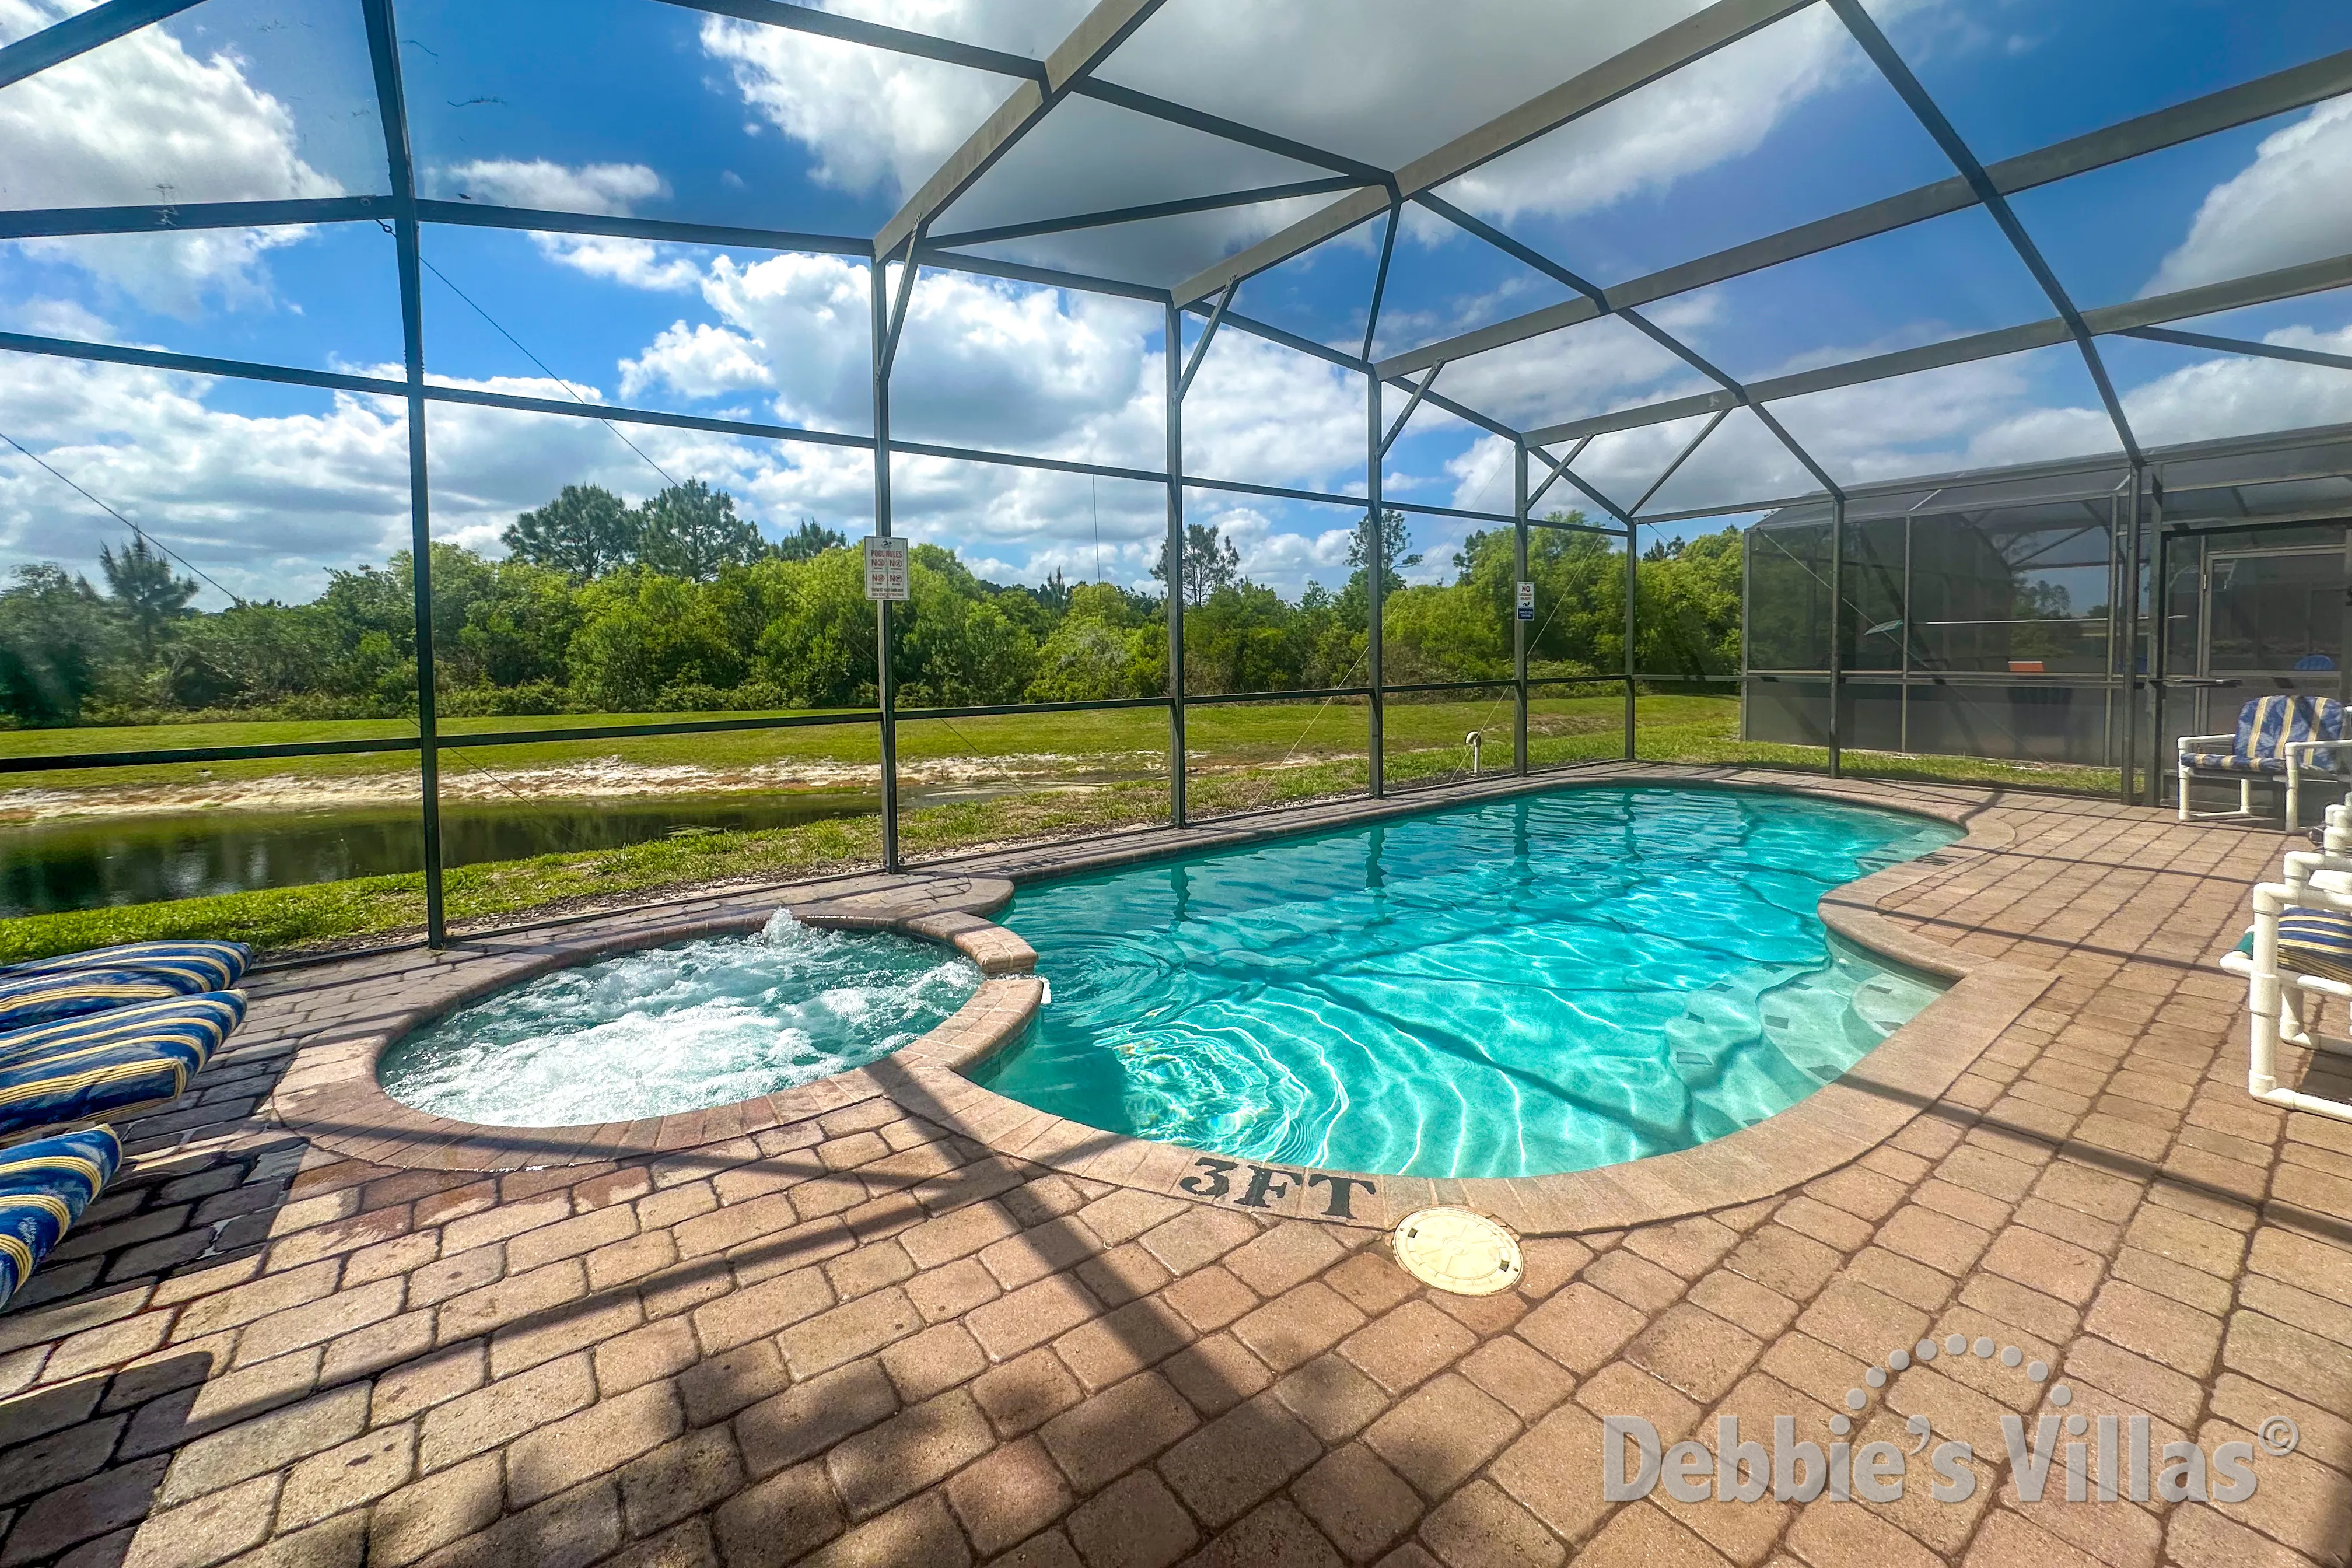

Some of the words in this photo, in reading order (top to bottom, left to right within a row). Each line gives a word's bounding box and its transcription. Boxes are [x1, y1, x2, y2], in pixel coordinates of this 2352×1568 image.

[871, 550, 885, 558] POOL
[886, 550, 902, 558] RULES
[1179, 1157, 1376, 1219] 3FT
